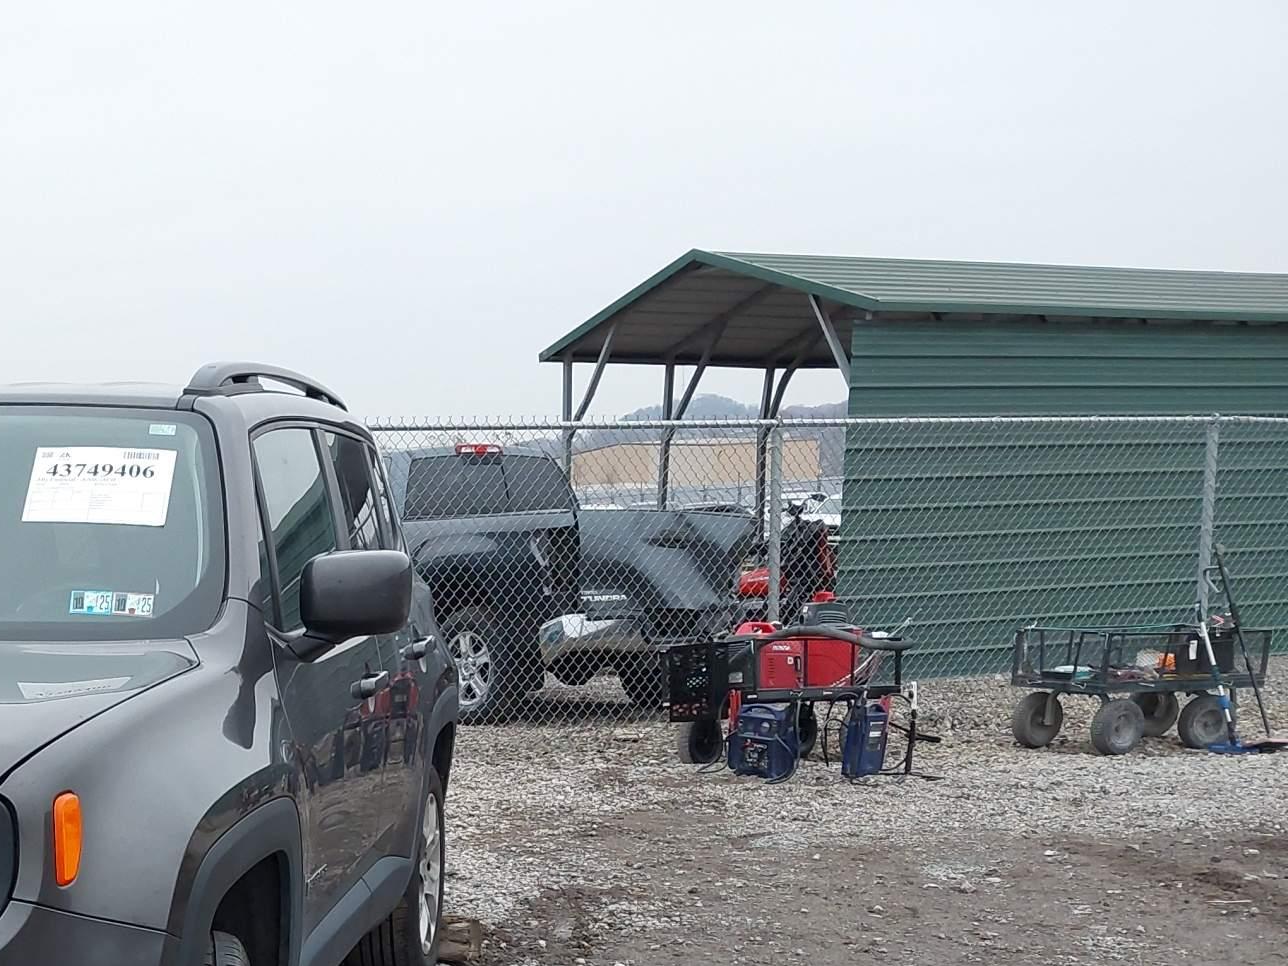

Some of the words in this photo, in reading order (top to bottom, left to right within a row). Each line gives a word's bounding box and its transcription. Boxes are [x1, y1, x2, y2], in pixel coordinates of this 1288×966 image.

[46, 463, 155, 479] 43749406
[99, 595, 111, 610] 25
[141, 597, 153, 613] 25
[580, 594, 628, 602] TUNDRA
